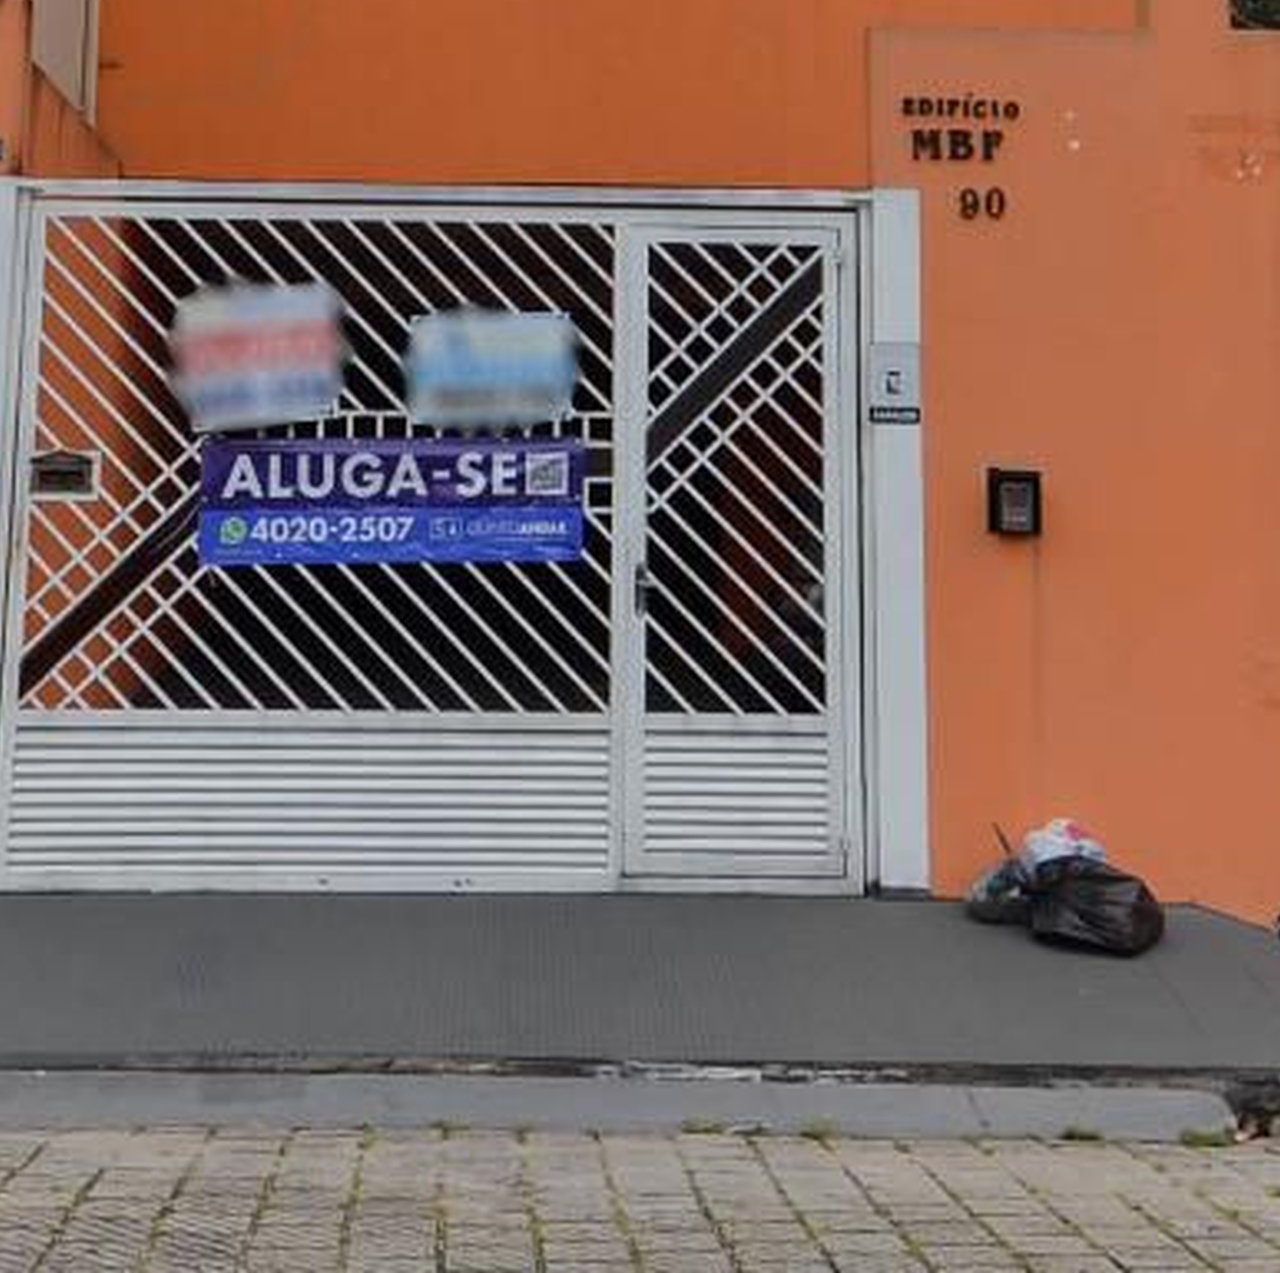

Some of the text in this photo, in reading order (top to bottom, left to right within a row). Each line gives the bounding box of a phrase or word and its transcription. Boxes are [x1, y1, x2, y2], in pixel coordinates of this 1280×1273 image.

[901, 92, 1020, 120] EDIFÍCIO
[911, 128, 1004, 162] MBF
[960, 187, 1006, 221] 90
[221, 451, 517, 499] ALUGA-SE
[250, 516, 415, 543] 4020-2507
